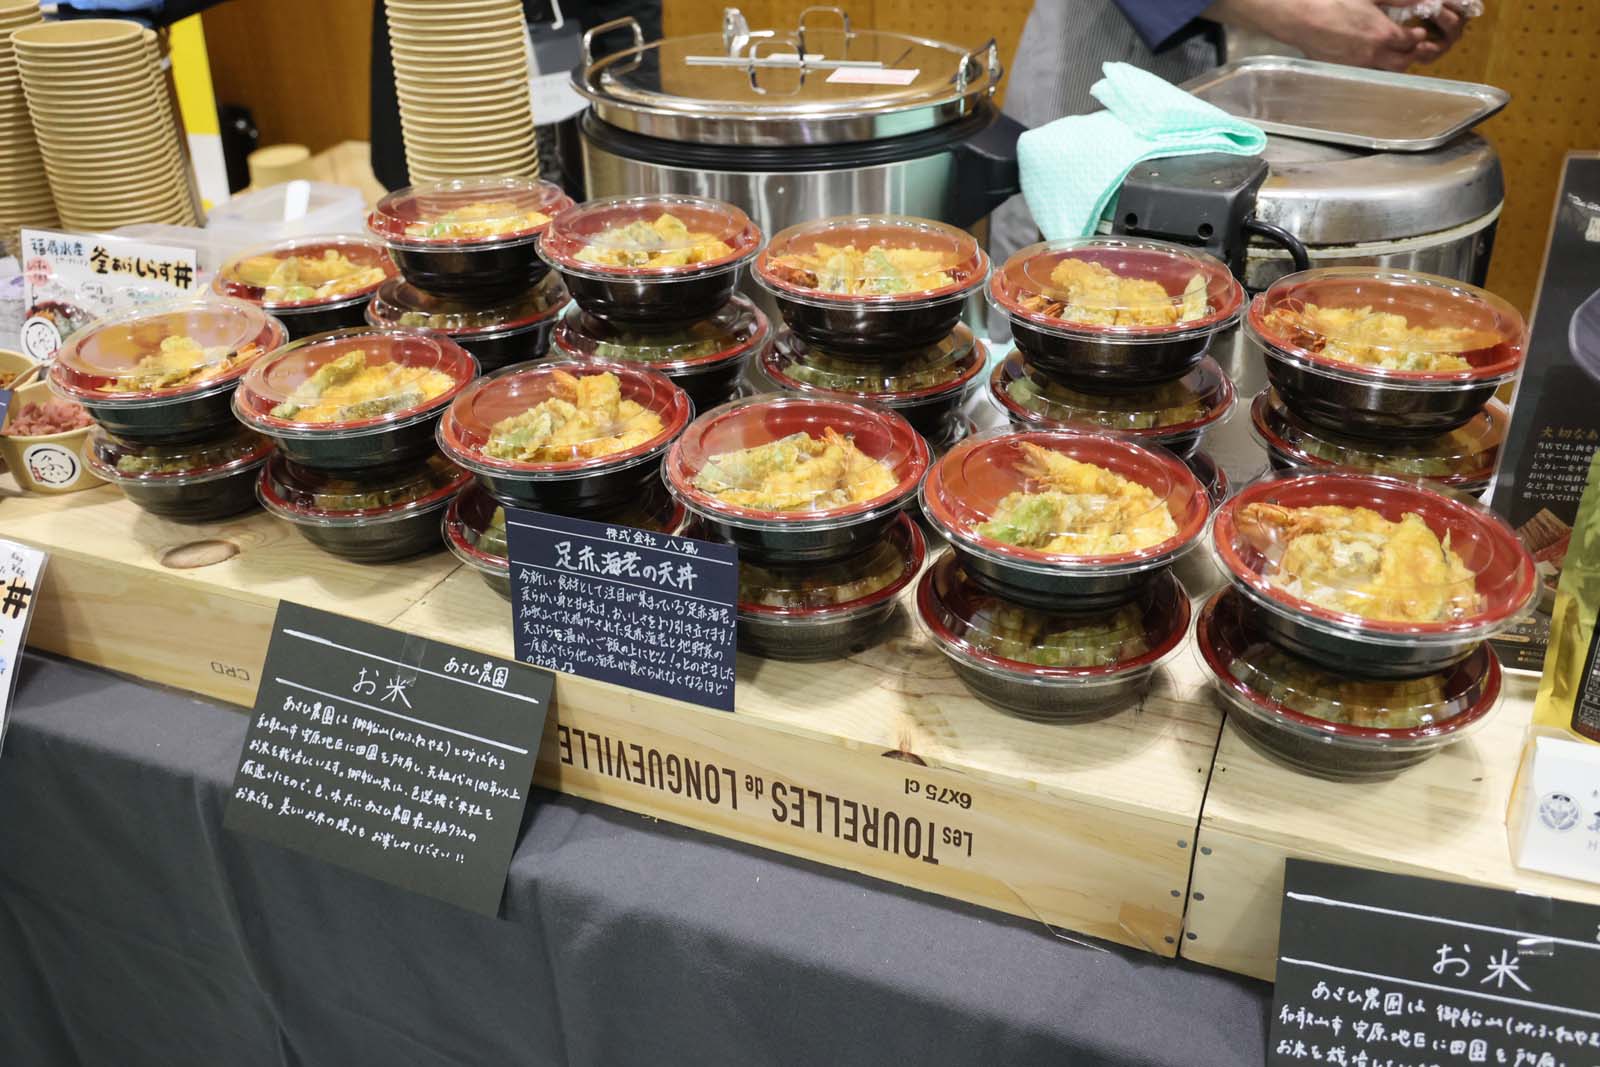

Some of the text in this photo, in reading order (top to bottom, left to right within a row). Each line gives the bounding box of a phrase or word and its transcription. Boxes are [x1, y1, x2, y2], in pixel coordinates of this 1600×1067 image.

[605, 527, 656, 546] 株式会社
[554, 541, 698, 591] 足赤海老の天丼
[352, 666, 413, 709] お米
[443, 656, 509, 689] あさひ農園
[558, 724, 973, 865] Les TOURELLES de LONGUEVILLE
[925, 784, 973, 811] 6x75
[1432, 944, 1533, 993] お米
